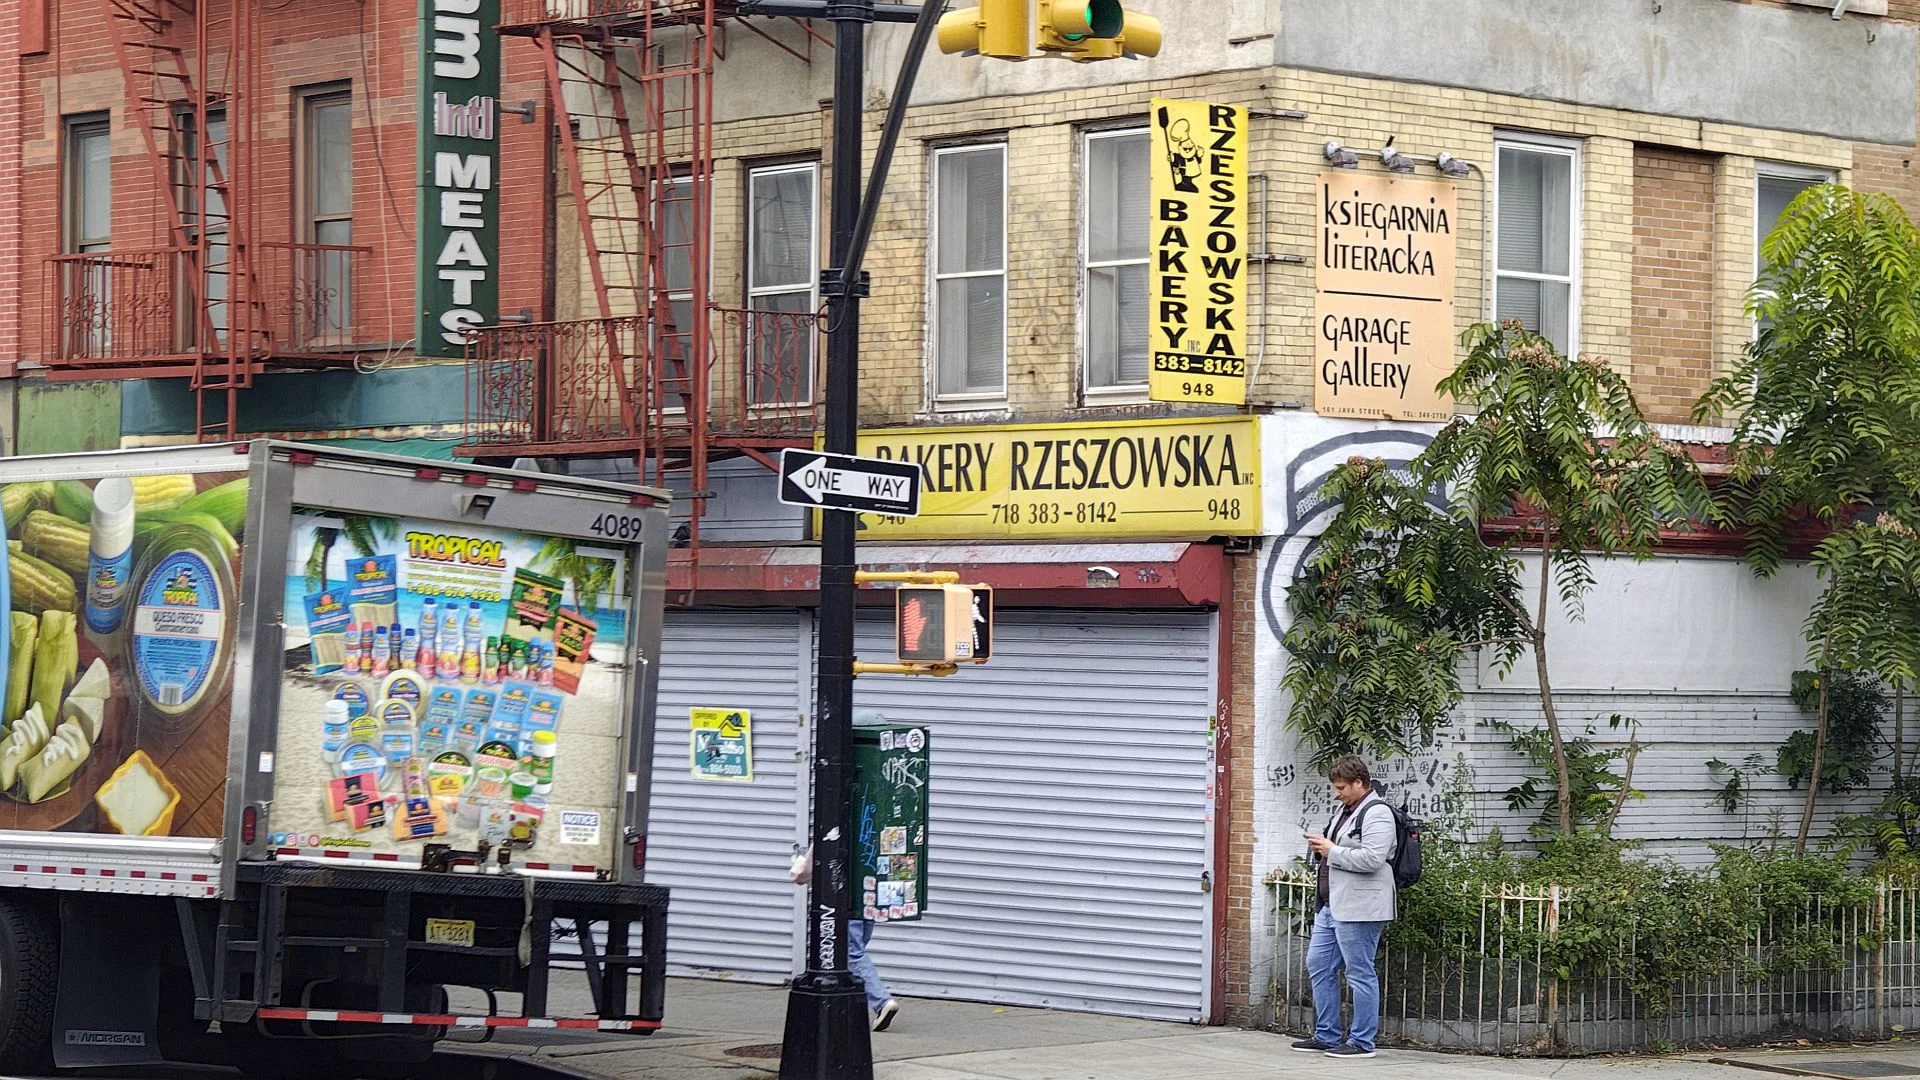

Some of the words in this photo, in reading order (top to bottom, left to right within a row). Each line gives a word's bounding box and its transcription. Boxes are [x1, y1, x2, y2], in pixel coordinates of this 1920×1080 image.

[434, 92, 493, 140] Intl
[1201, 104, 1241, 356] RZESZOWSKA
[436, 152, 491, 346] MEATS
[1159, 199, 1189, 348] BAKERY
[1156, 356, 1244, 376] 383-8142
[1181, 381, 1215, 398] 948
[877, 443, 995, 493] KERY
[1011, 434, 1243, 493] RZESZOWSKA
[805, 469, 842, 492] ONE
[868, 476, 905, 498] WAY
[590, 513, 642, 540] 4089
[992, 504, 1020, 526] 718
[1207, 498, 1241, 522] 948
[406, 532, 506, 568] TROPICAL
[81, 1032, 142, 1044] MORGAN
